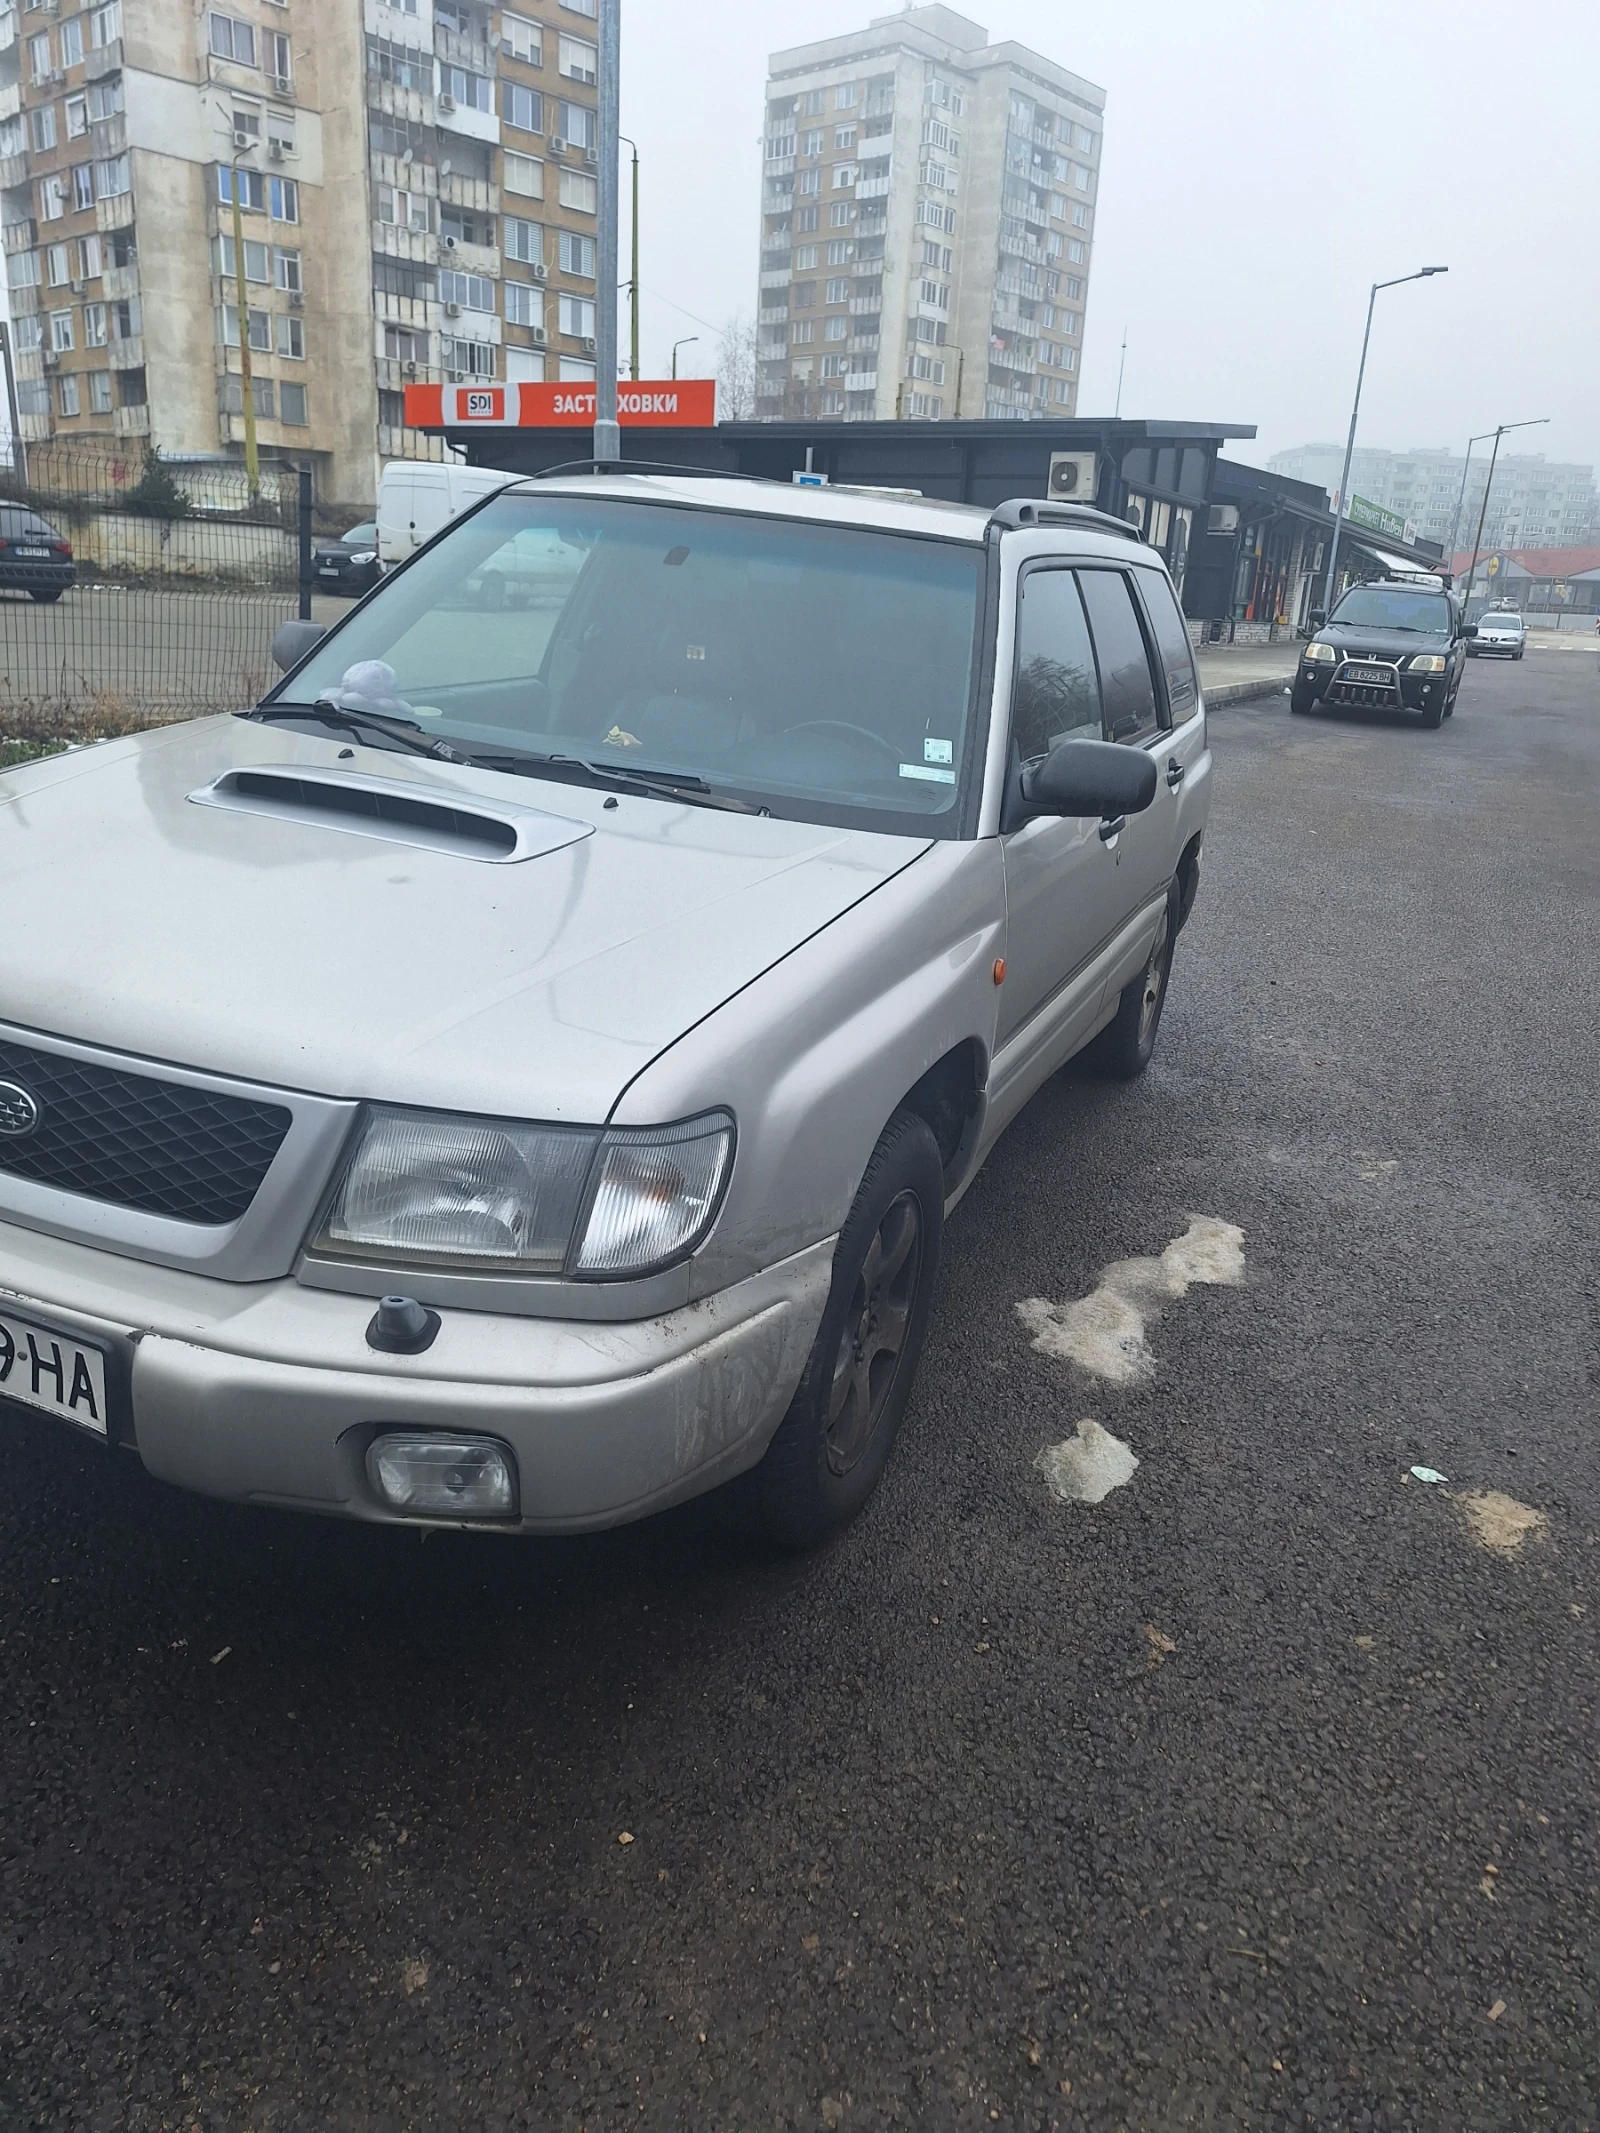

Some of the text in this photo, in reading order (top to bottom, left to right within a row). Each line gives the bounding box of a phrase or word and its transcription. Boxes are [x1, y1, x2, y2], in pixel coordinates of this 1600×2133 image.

[470, 395, 491, 410] SDI
[553, 394, 677, 413] ЗАСТХОВКИ
[26, 1332, 98, 1420] HA
